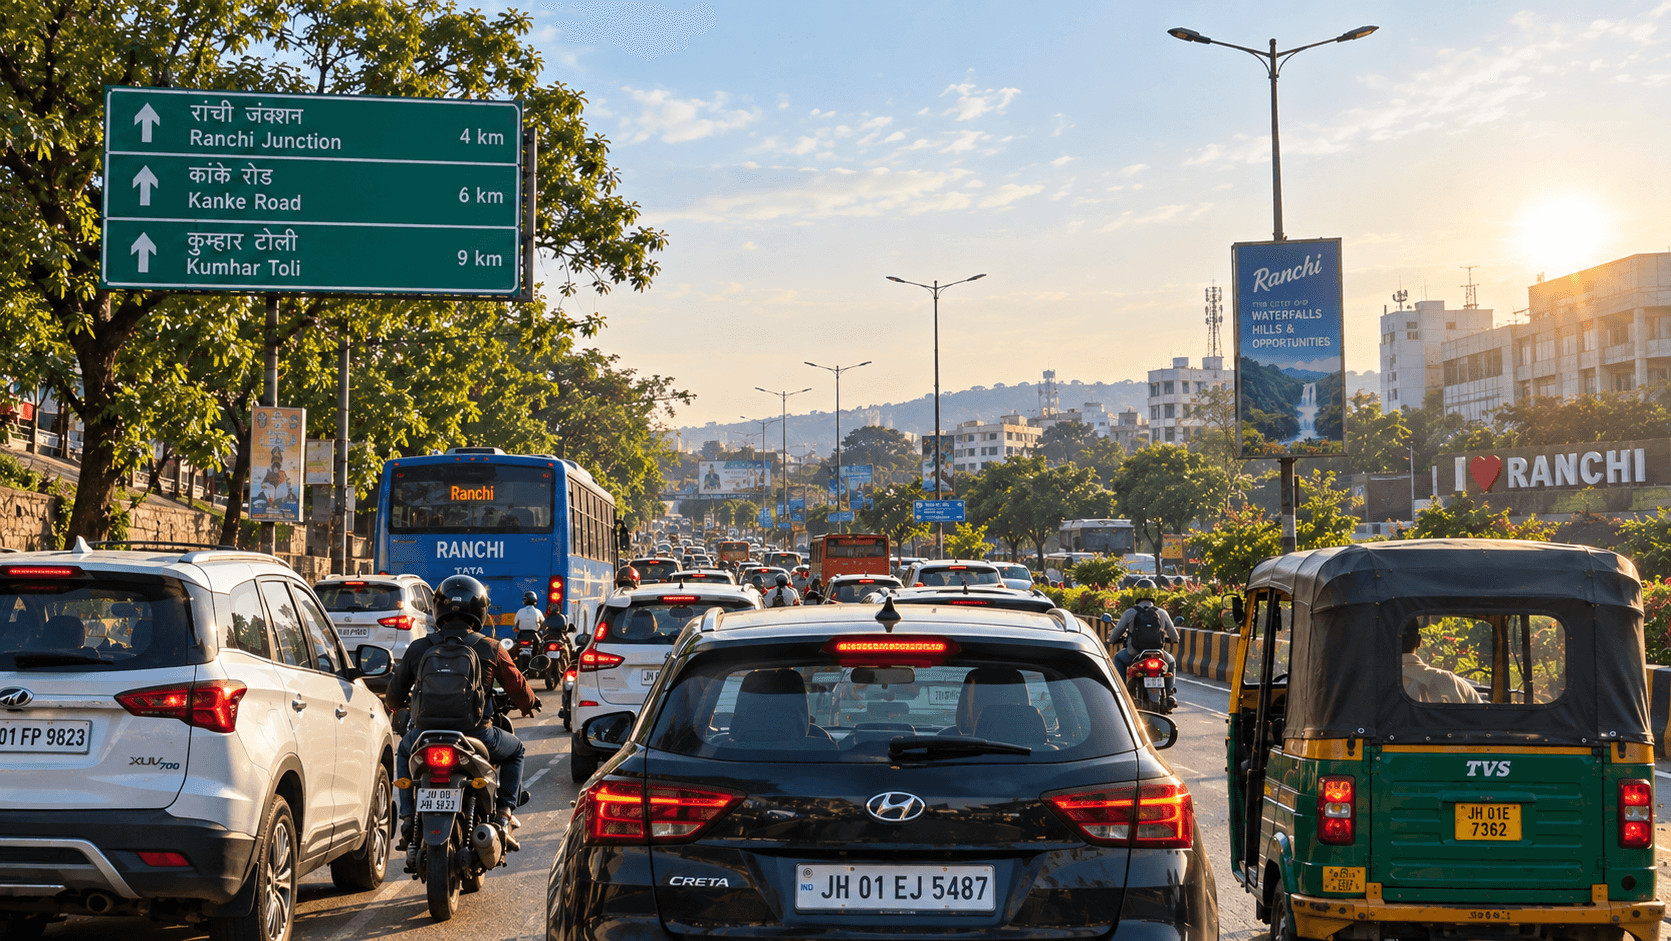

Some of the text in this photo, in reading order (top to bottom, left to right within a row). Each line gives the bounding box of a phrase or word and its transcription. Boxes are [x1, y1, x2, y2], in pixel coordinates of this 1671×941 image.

[190, 99, 304, 125] रांची जंक्शन
[190, 129, 341, 150] Ranchi Junction
[459, 127, 504, 145] 4 km
[188, 161, 274, 186] कांके रोड
[188, 191, 301, 211] Kanke Road
[458, 186, 503, 204] 6 km
[187, 227, 299, 256] कुम्हार टोली
[457, 249, 502, 267] 9 km
[186, 258, 300, 277] Kumhar Toli
[1252, 253, 1323, 293] Ranchi
[1252, 308, 1323, 321] WATERFALLS
[1252, 323, 1295, 335] HILLS &
[1252, 336, 1331, 349] OPPORTUNITIES
[1454, 448, 1646, 492] I RANCHI
[451, 485, 494, 501] Ranchi
[436, 540, 504, 559] RANCHI
[454, 566, 484, 575] TATA
[0, 727, 85, 747] 01 FP 9823
[1466, 760, 1511, 777] TVS
[1467, 806, 1510, 820] JH 01E
[1471, 822, 1507, 837] 7362
[668, 876, 730, 888] CRETA
[800, 883, 814, 892] IND
[821, 875, 988, 901] JH 01 EJ 5487
